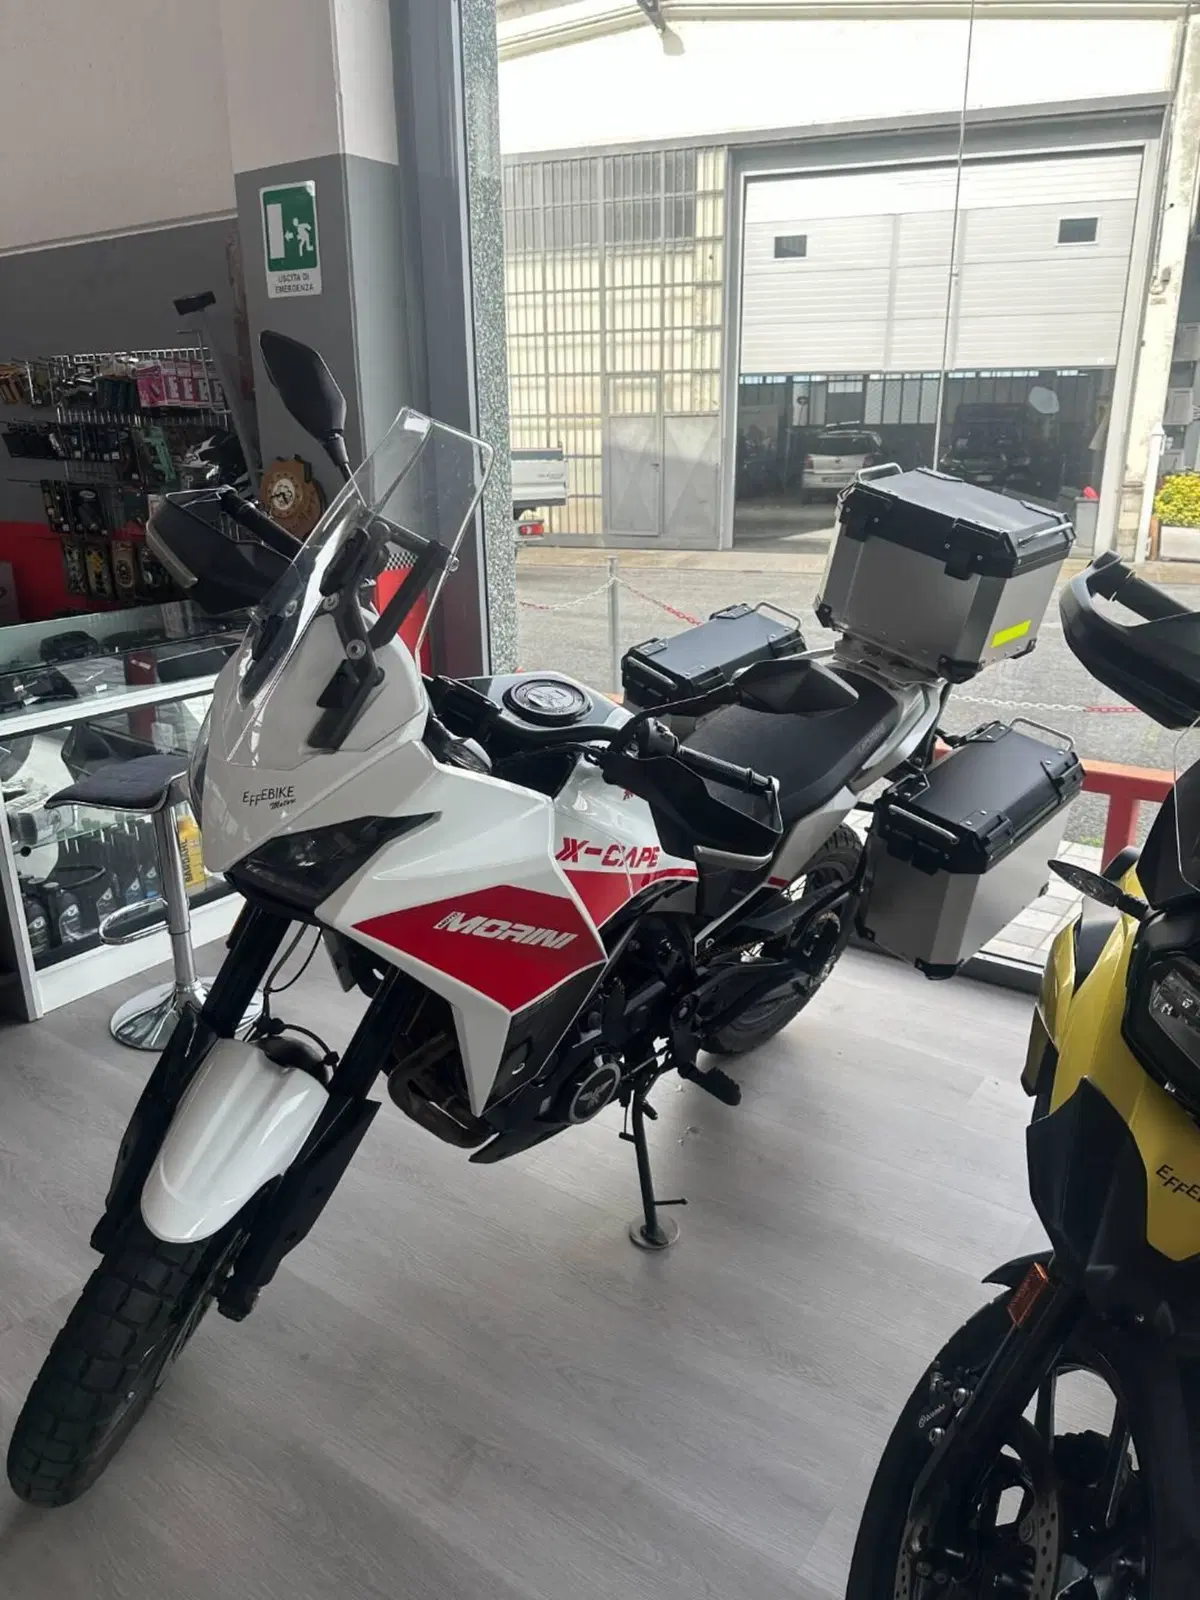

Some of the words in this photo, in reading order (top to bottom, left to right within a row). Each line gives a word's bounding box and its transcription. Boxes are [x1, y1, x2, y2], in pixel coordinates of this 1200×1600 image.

[275, 283, 314, 293] EMERGENZA
[278, 274, 301, 283] USCITA
[242, 786, 295, 806] EFFEBIKE
[555, 837, 660, 868] X-CAPE
[446, 912, 578, 949] MORINI
[1156, 1164, 1200, 1203] EFFE
